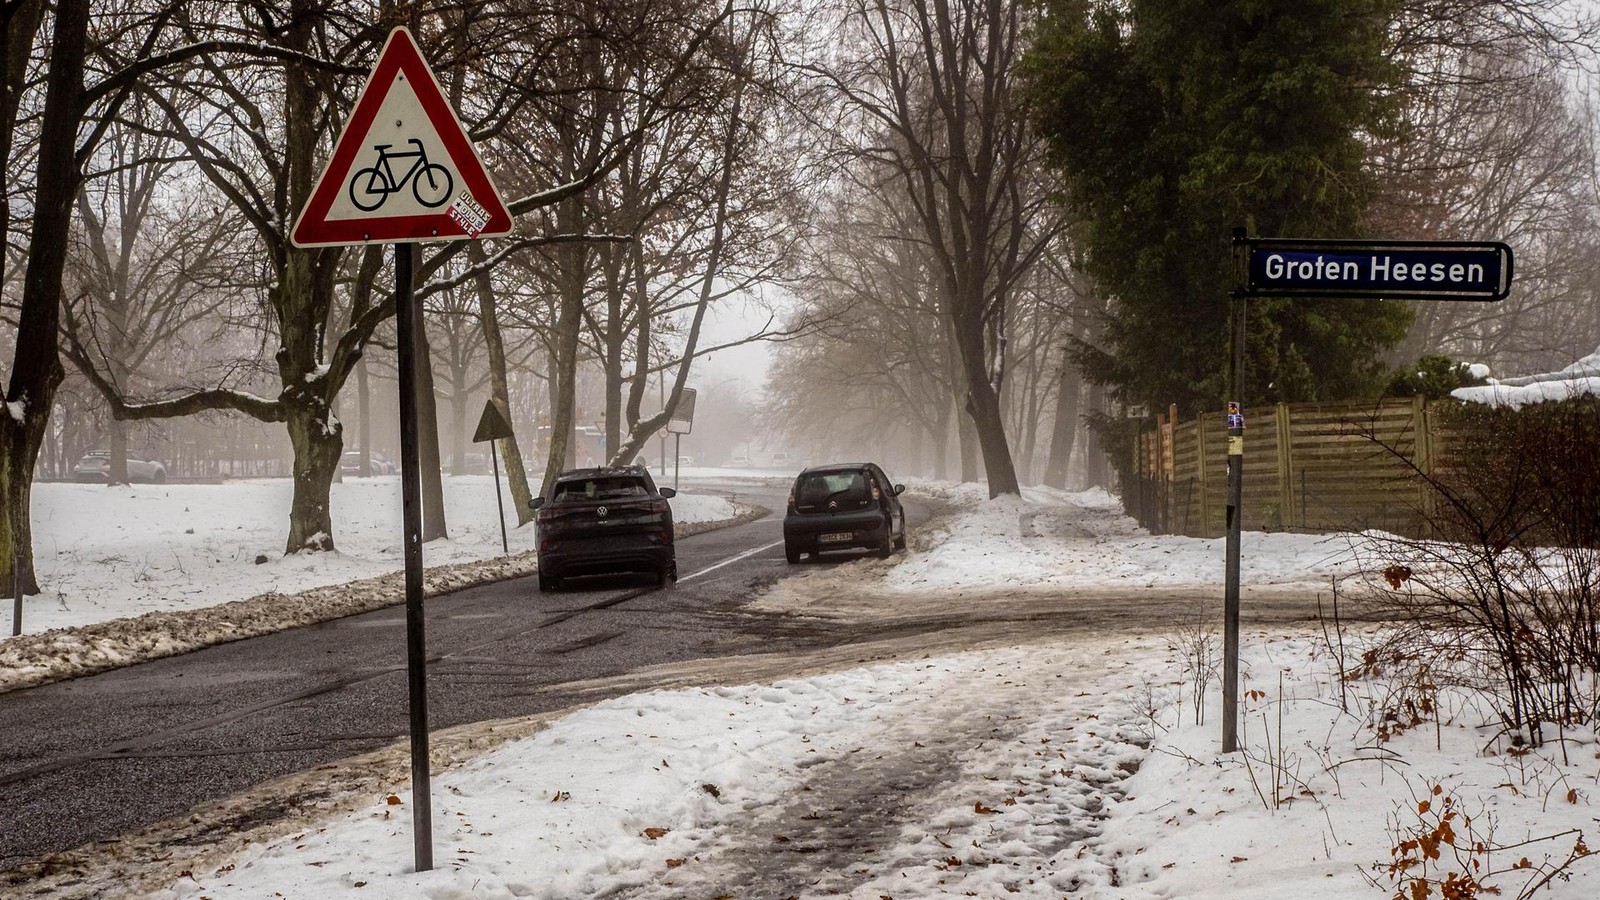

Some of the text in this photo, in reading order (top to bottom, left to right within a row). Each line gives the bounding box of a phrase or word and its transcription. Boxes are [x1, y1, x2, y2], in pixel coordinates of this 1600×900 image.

[460, 191, 490, 222] ULTRAS
[460, 206, 477, 224] OLD
[449, 209, 475, 236] STYLE
[1265, 254, 1484, 283] Groten Heesen
